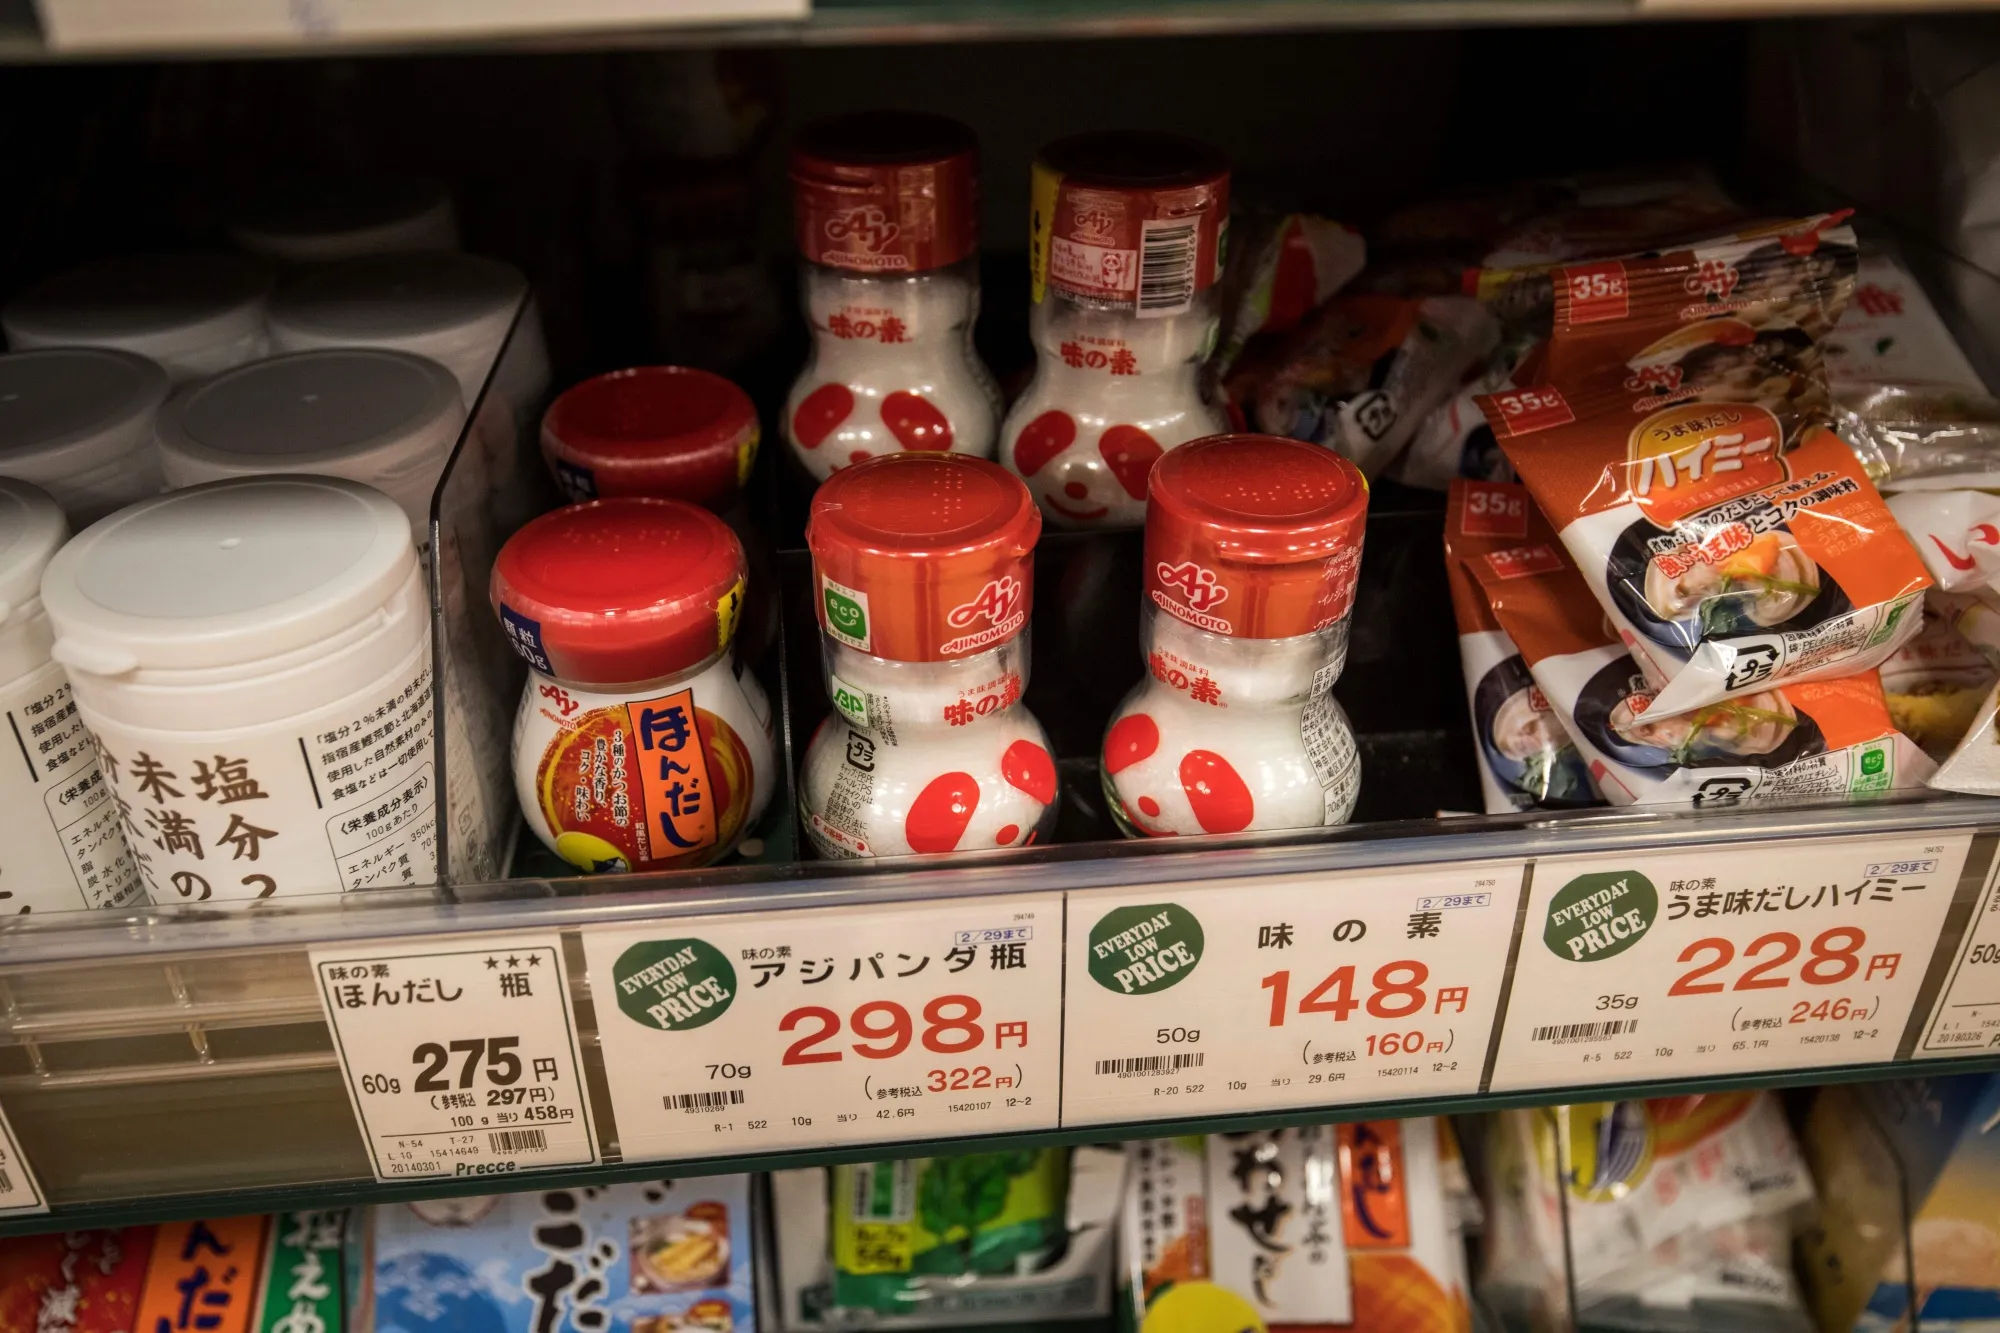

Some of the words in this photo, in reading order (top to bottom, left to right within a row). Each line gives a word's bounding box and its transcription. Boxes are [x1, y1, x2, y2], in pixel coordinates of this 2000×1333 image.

[1572, 274, 1623, 299] 35g
[829, 314, 906, 343] 味の素
[1060, 341, 1136, 375] 味の素
[1654, 412, 1741, 441] うま味だし
[1638, 433, 1773, 496] ハイミー
[1470, 493, 1523, 514] 35g
[830, 599, 859, 618] eco
[1152, 590, 1232, 634] AJINOMOTO
[940, 611, 1024, 654] AJINOMOTO
[1149, 651, 1221, 706] 味の素
[944, 674, 1021, 726] 味の素
[38, 719, 84, 755] 使用した
[1865, 753, 1883, 765] eco
[612, 730, 628, 826] 3種のかつお節の
[640, 705, 704, 849] ほんだし
[1667, 878, 1926, 921] うま味だしハイミー
[1670, 877, 1716, 893] 味の素
[1552, 879, 1630, 928] EVERYDAY
[1580, 905, 1614, 931] LOW
[1093, 911, 1172, 959] EVERYDAY
[1566, 908, 1646, 960] PRICE
[742, 945, 792, 961] 味の素
[1128, 936, 1159, 963] LOW
[329, 963, 390, 980] 味の素
[619, 946, 698, 995] EVERYDAY
[1113, 941, 1195, 993] PRICE
[334, 979, 463, 1009] ほんだし
[500, 972, 533, 998] 瓶
[654, 972, 691, 999] LOW
[646, 976, 730, 1029] PRICE
[1595, 993, 1638, 1011] 35g
[1156, 1026, 1201, 1044] 50g
[1583, 1053, 1601, 1063] R-5
[1614, 1051, 1633, 1061] 522
[1655, 1048, 1673, 1058] 10g
[361, 1073, 402, 1095] 60g
[705, 1062, 752, 1080] 70g
[1153, 1086, 1179, 1096] R-20
[1185, 1083, 1205, 1094] 522
[1227, 1081, 1248, 1092] 10g
[1377, 1066, 1419, 1077] 15420114
[684, 1104, 726, 1114] 49310269
[714, 1122, 734, 1133] R-1
[748, 1119, 768, 1130] 522
[791, 1116, 812, 1127] 10g
[948, 1101, 992, 1113] 15420107
[430, 1146, 480, 1158] 15414649
[391, 1161, 442, 1174] 20140301
[456, 1160, 517, 1177] Precce
